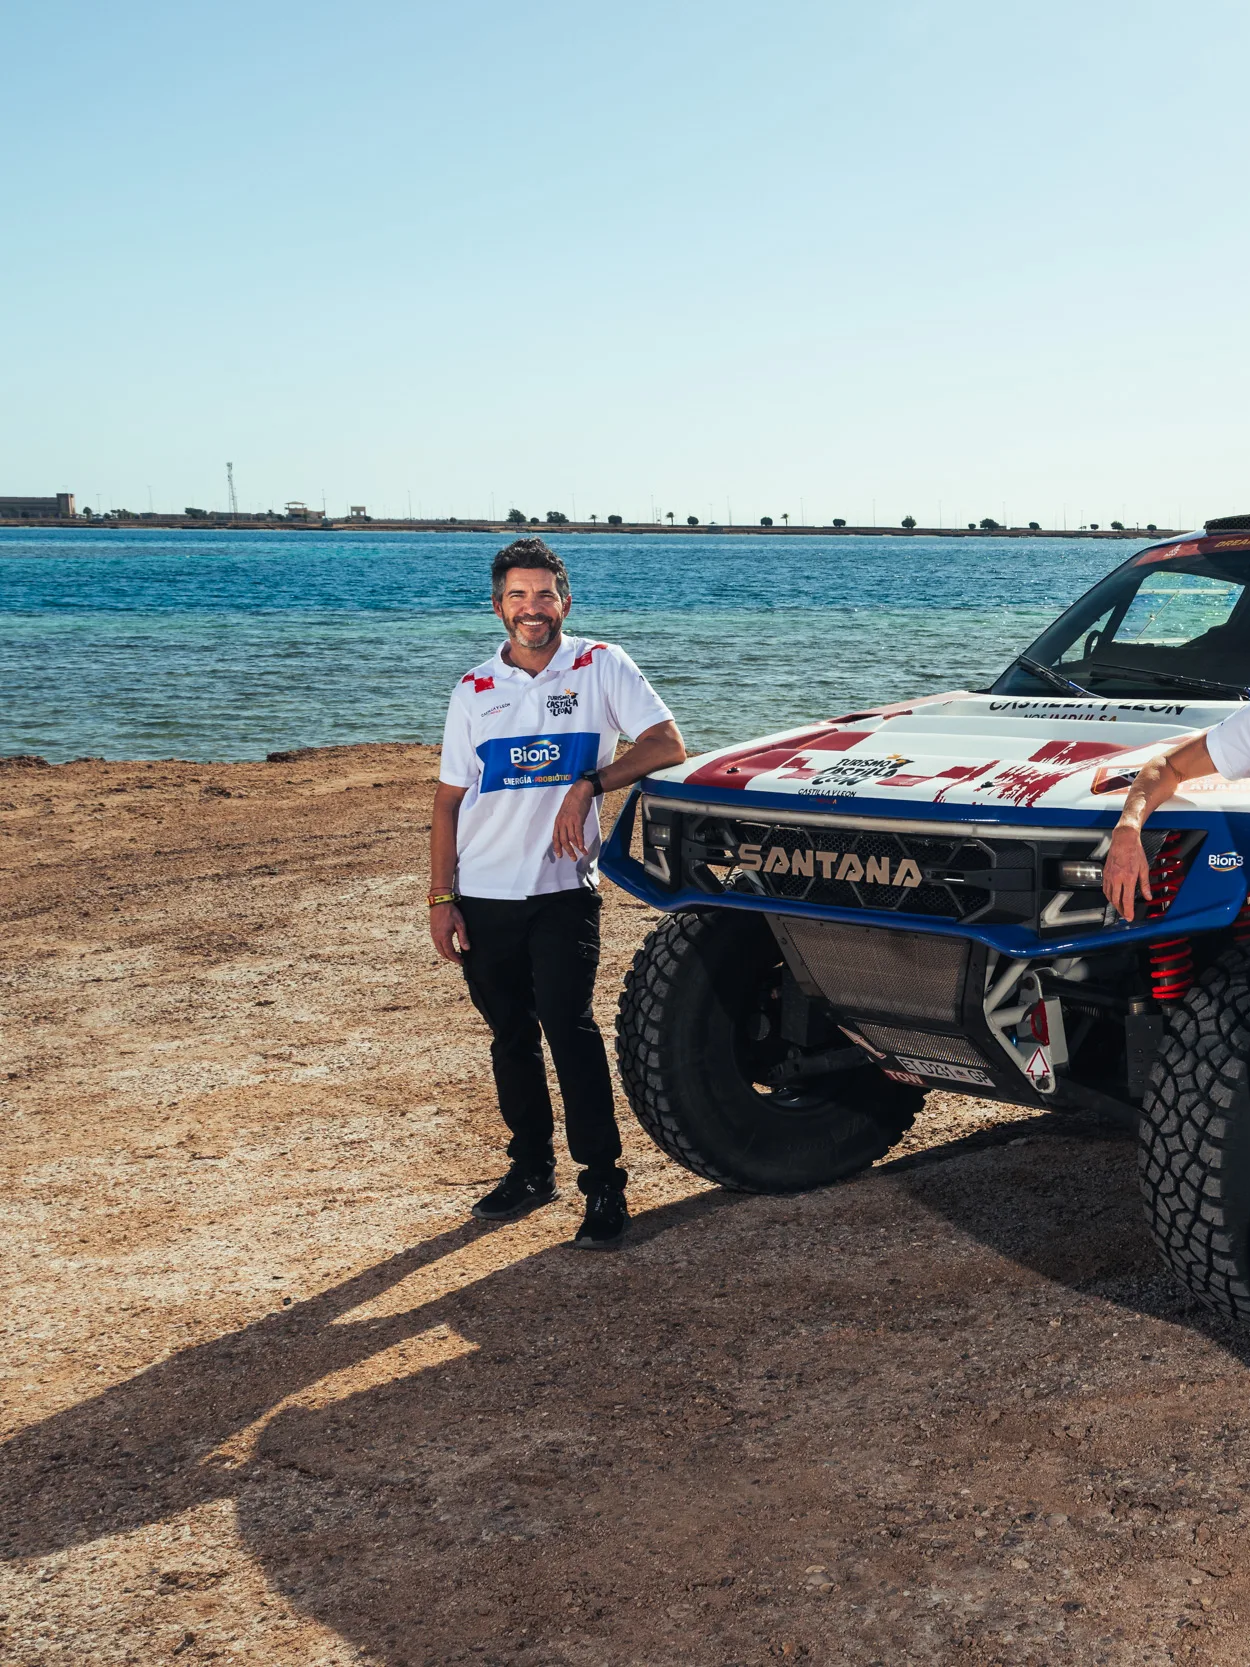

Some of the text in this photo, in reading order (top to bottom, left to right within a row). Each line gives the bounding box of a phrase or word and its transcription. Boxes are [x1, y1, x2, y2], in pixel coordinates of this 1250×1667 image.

[546, 699, 579, 709] CASTILLA
[509, 744, 561, 764] Bion3
[836, 758, 891, 767] TURISMO
[503, 775, 532, 786] ENERGÍA
[738, 843, 923, 888] SANTANA
[1208, 854, 1244, 866] Bion3
[885, 1069, 925, 1084] TOW
[900, 1058, 922, 1073] ET
[923, 1062, 955, 1079] D231
[968, 1071, 990, 1084] GP
